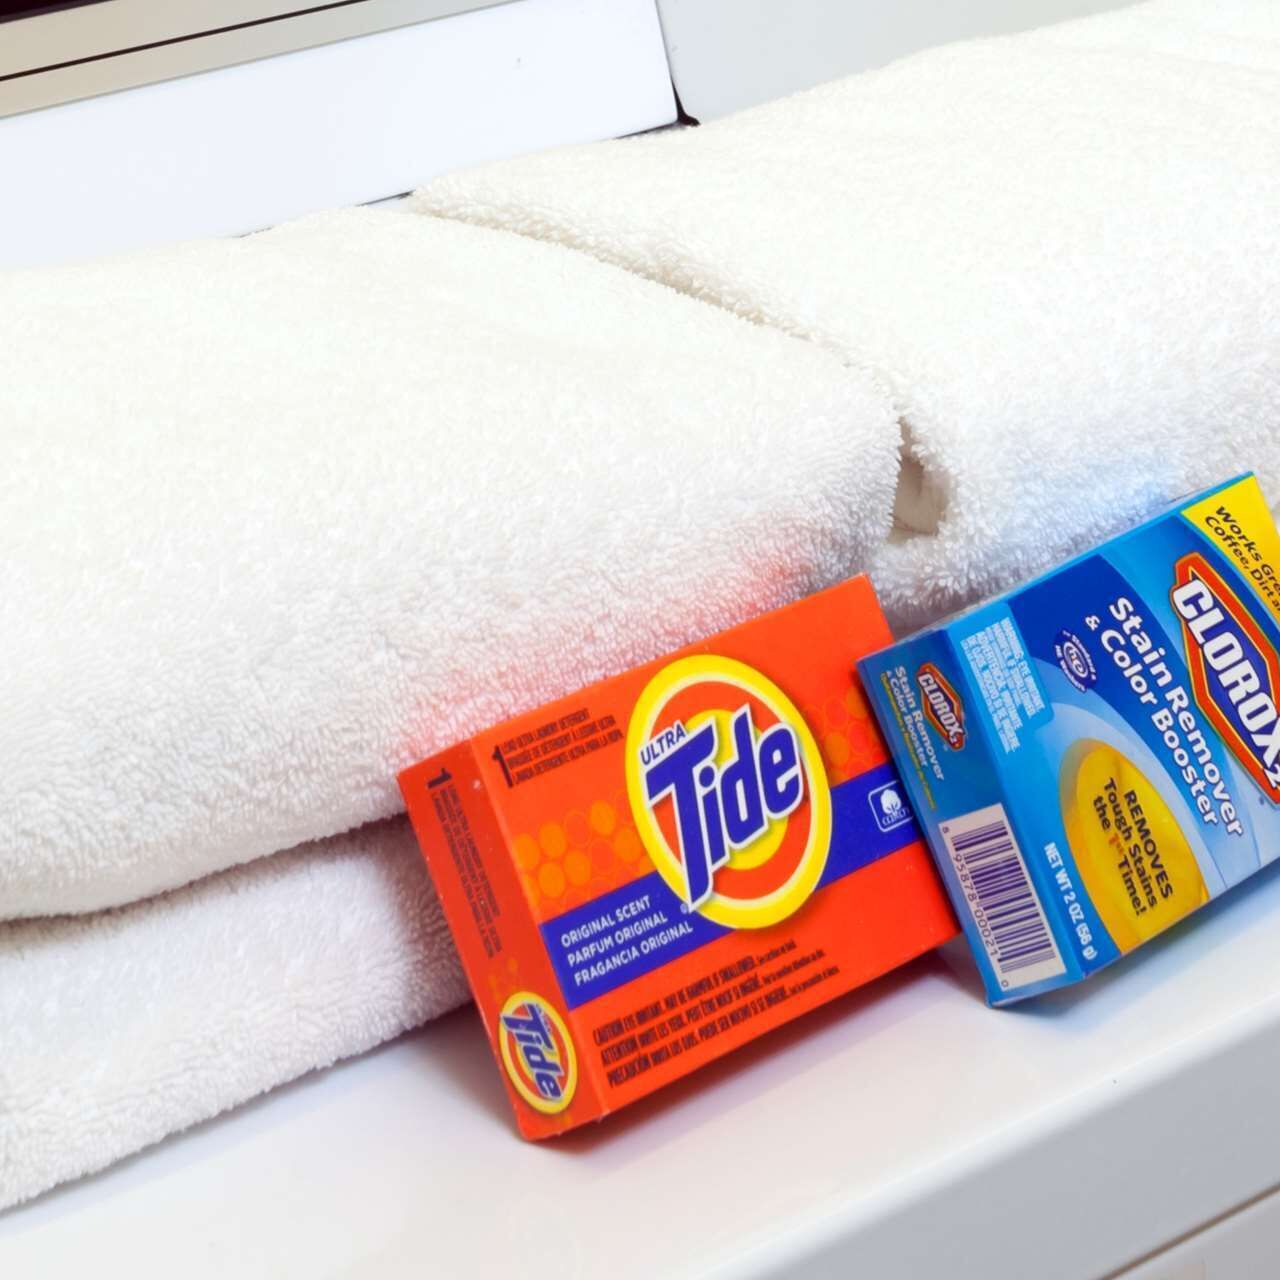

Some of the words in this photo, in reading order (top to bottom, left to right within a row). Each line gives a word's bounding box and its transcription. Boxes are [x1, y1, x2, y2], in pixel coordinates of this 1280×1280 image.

[1205, 516, 1251, 570] Coffee,
[1250, 569, 1274, 598] Dirt
[1216, 506, 1261, 563] Works
[640, 725, 686, 766] ULTRA
[890, 678, 908, 713] Color
[903, 715, 929, 767] Booster
[895, 666, 917, 708] Stain
[912, 709, 945, 781] Remover
[1085, 615, 1101, 631] &
[1100, 629, 1158, 706] Color
[1151, 708, 1218, 826] Booster
[1109, 596, 1172, 688] Stain
[1164, 685, 1243, 836] Remover
[644, 704, 805, 910] Tide
[1104, 777, 1133, 842] Tough
[1129, 843, 1158, 908] Stains
[1124, 790, 1174, 899] REMOVES
[1044, 842, 1063, 869] NET
[1056, 869, 1072, 891] WT
[1093, 796, 1111, 831] the
[1118, 855, 1148, 916] Time!
[561, 914, 616, 948] ORIGINAL
[616, 895, 651, 922] SCENT
[567, 935, 614, 967] PARFUM
[614, 911, 668, 944] ORIGINAL
[953, 854, 978, 903] 95878
[974, 908, 999, 957] 00021
[1064, 892, 1076, 905] 2
[1068, 902, 1084, 924] OZ
[574, 946, 640, 986] FRAGANCIA
[640, 921, 694, 954] ORIGINAL
[501, 1001, 564, 1098] Tide
